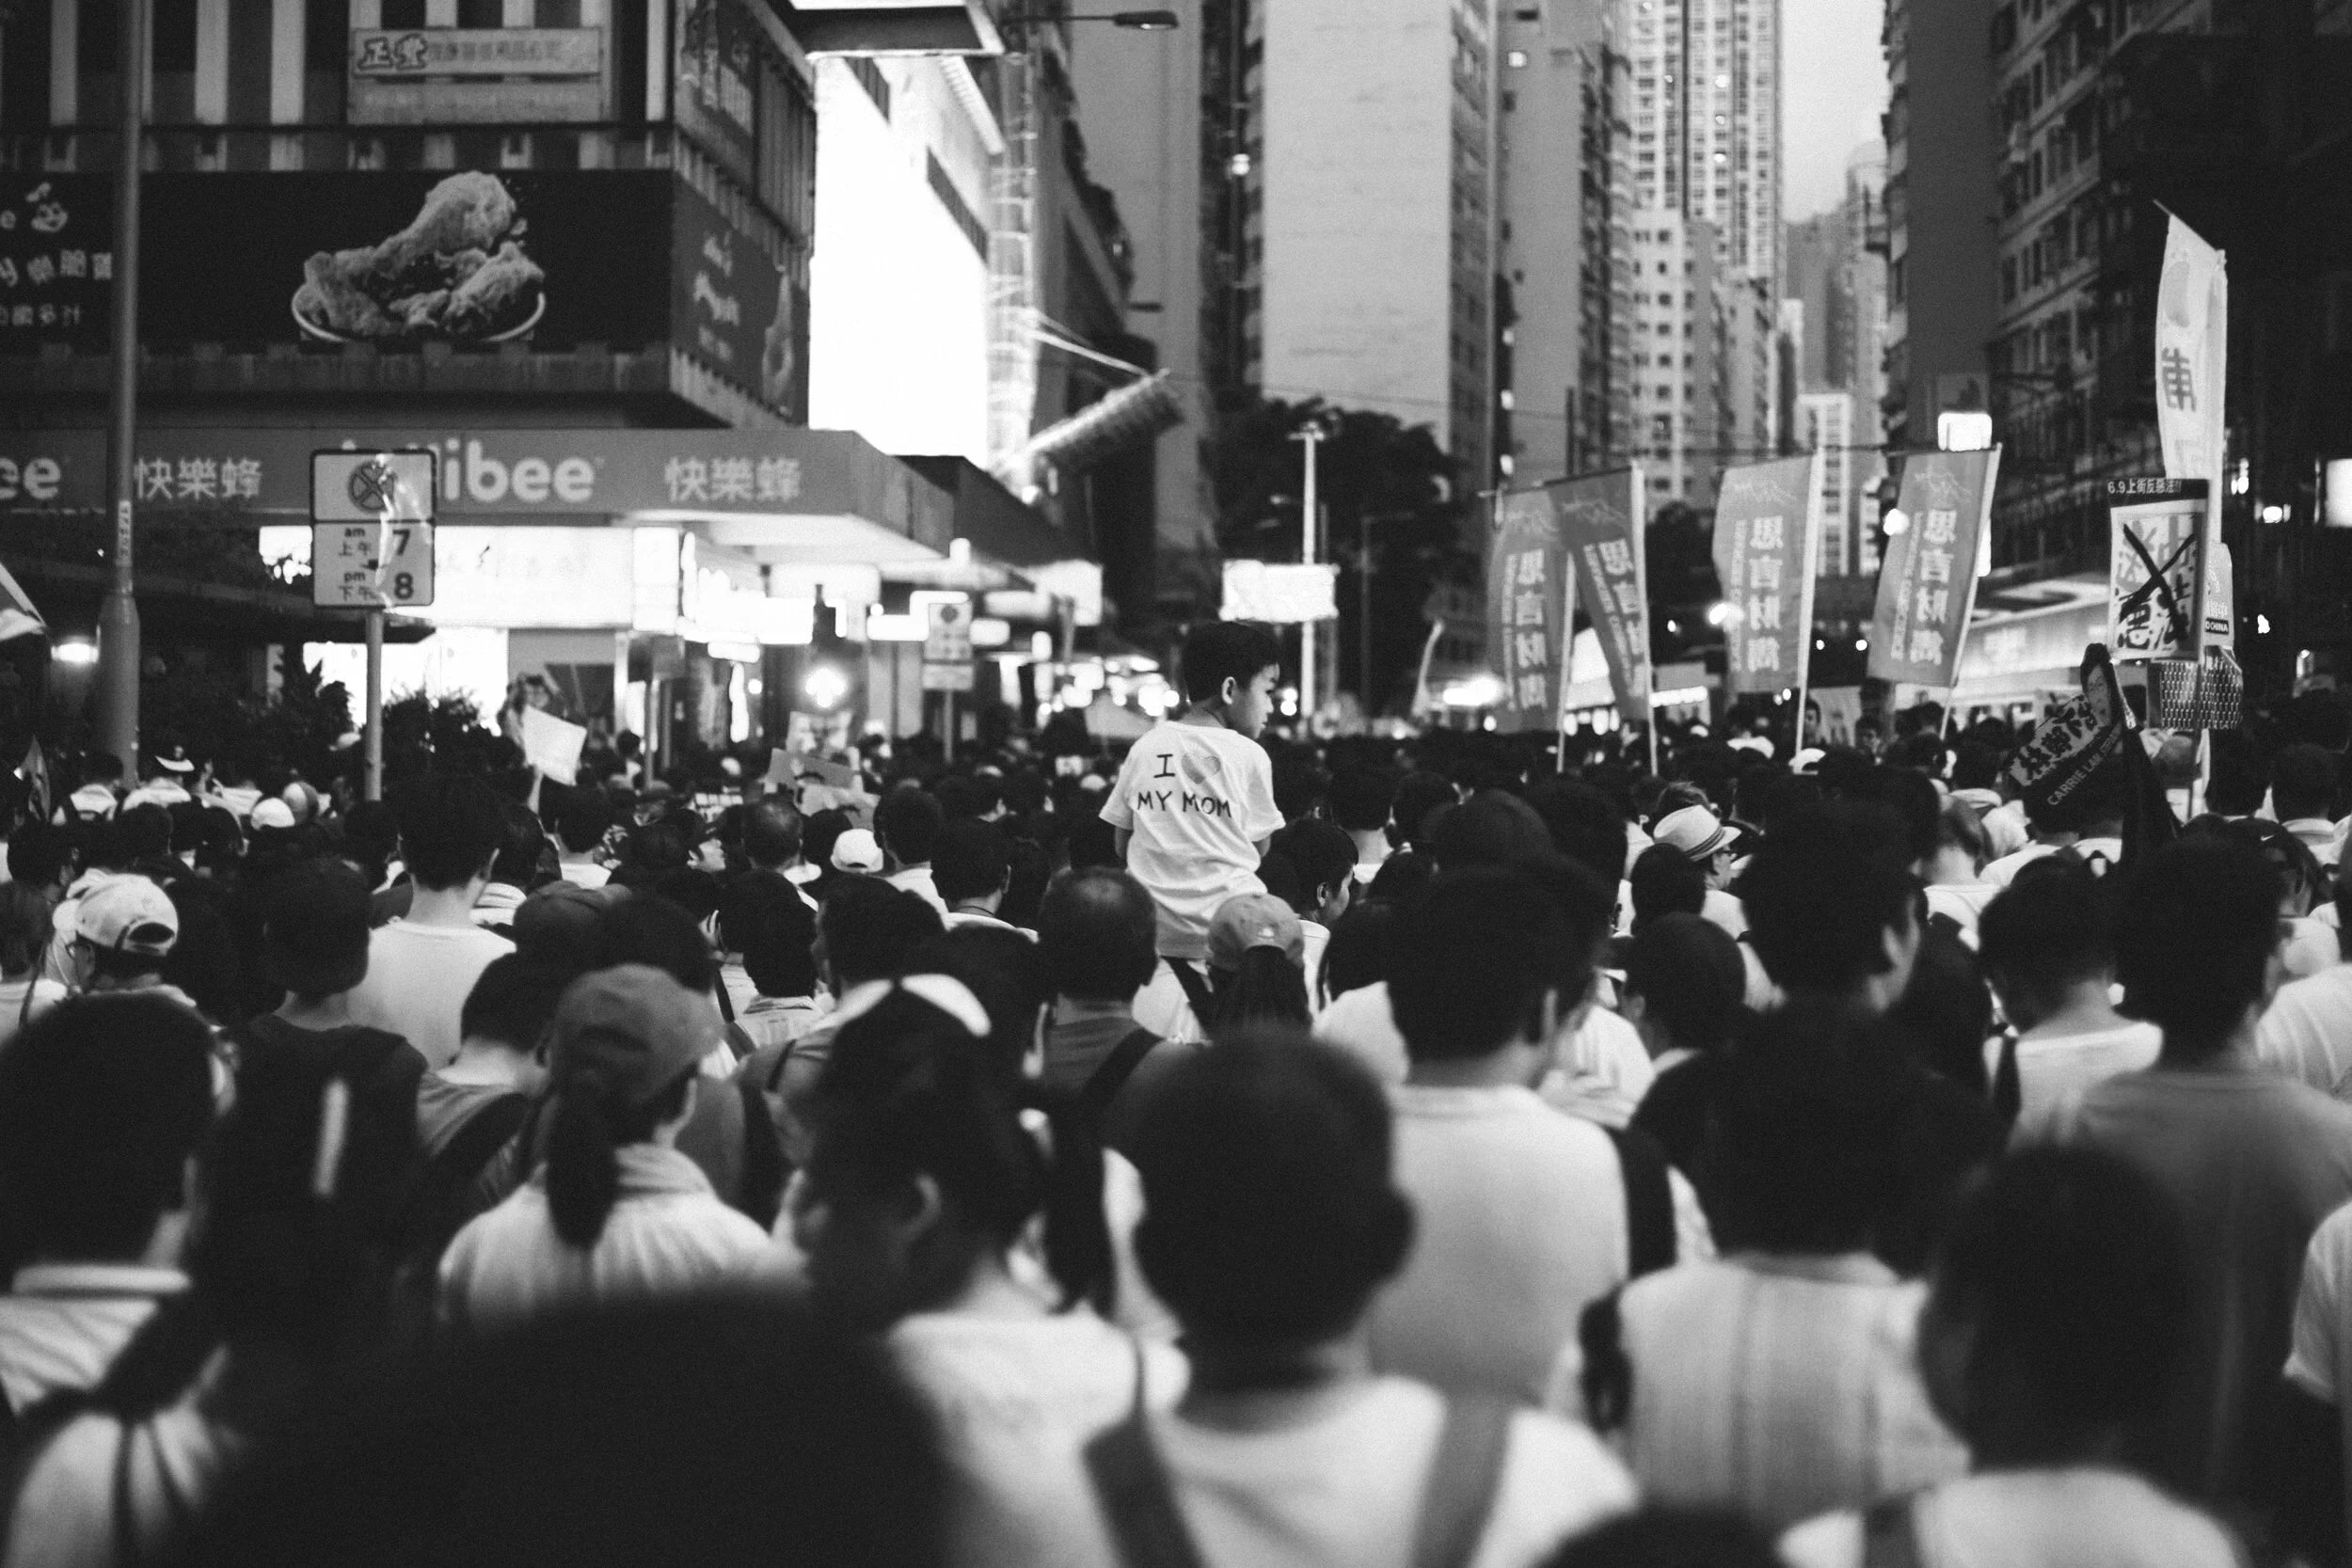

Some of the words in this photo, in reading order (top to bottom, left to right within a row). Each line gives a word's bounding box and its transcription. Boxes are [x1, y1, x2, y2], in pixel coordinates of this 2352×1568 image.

[134, 458, 262, 500] 快樂蜂
[664, 456, 801, 502] 快樂蜂
[339, 541, 371, 556] 上午
[344, 528, 365, 537] am
[392, 529, 410, 556] 7
[338, 585, 370, 601] 下午
[344, 572, 365, 582] pm
[394, 572, 414, 600] 8
[1153, 753, 1175, 779] I
[2047, 769, 2087, 805] CARRIE
[1137, 790, 1172, 812] MY
[1182, 791, 1232, 818] MOM
